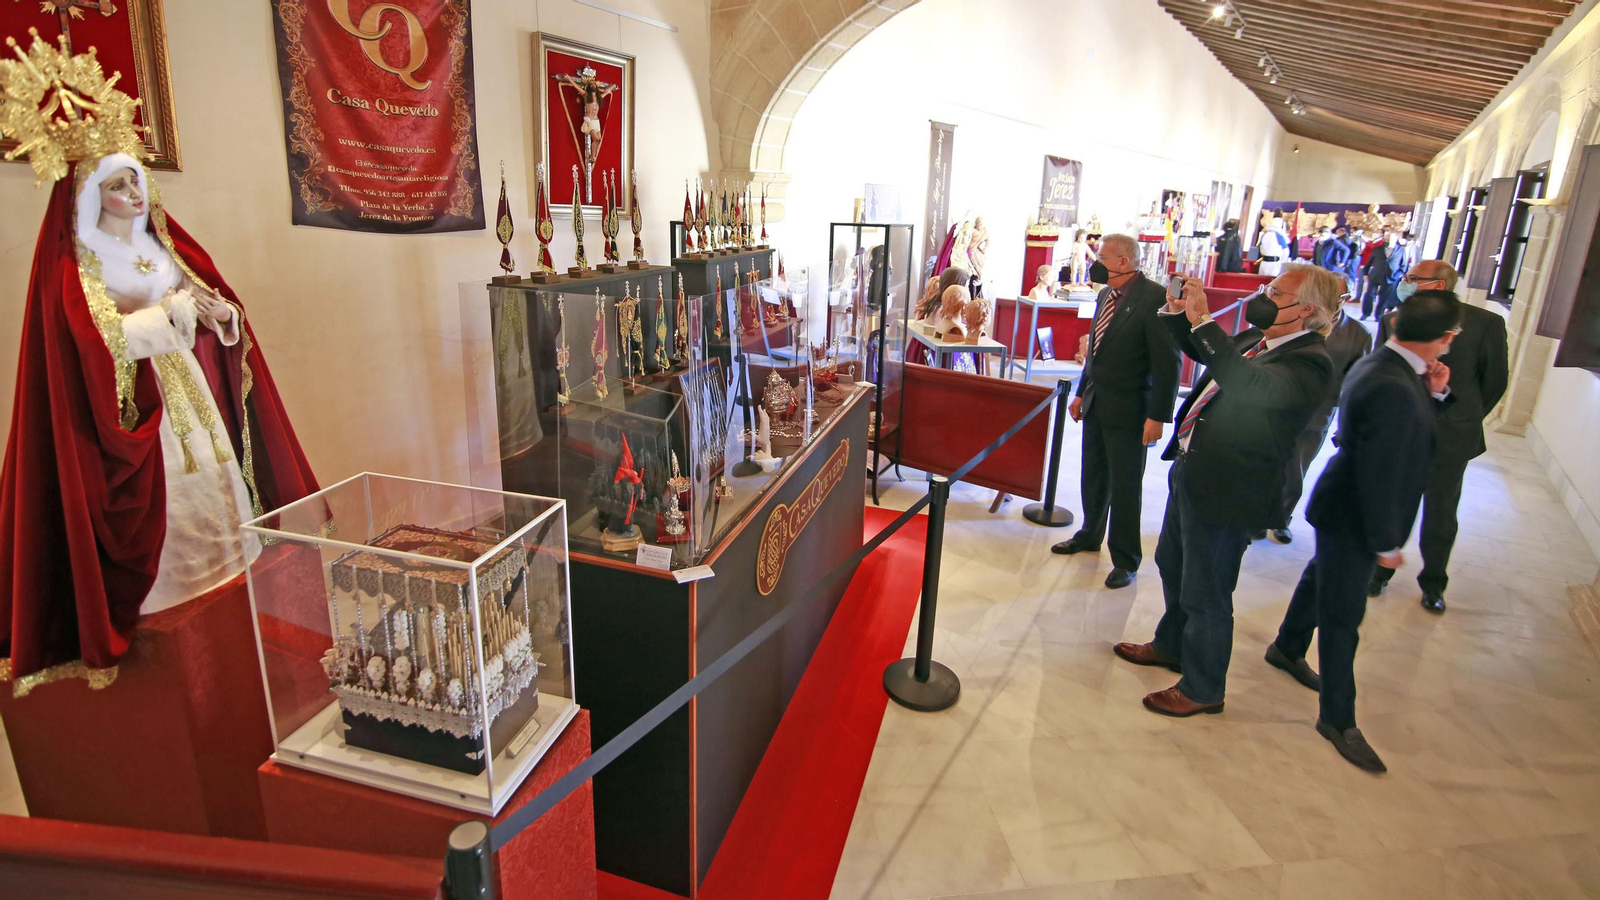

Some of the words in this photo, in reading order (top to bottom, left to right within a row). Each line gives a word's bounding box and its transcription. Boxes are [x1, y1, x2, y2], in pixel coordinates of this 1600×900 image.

[326, 88, 371, 110] Casa
[375, 98, 439, 117] Quevedo
[338, 138, 436, 154] www.casaquevedo.es
[363, 160, 417, 172] @casaquevedo
[377, 190, 391, 198] 342
[1046, 177, 1075, 203] Jerez
[360, 200, 380, 209] Plaza
[392, 203, 401, 211] la
[402, 203, 428, 211] Yerba,
[358, 211, 381, 220] Jerez
[382, 213, 392, 221] de
[392, 213, 401, 222] la
[402, 214, 434, 222] Frontera
